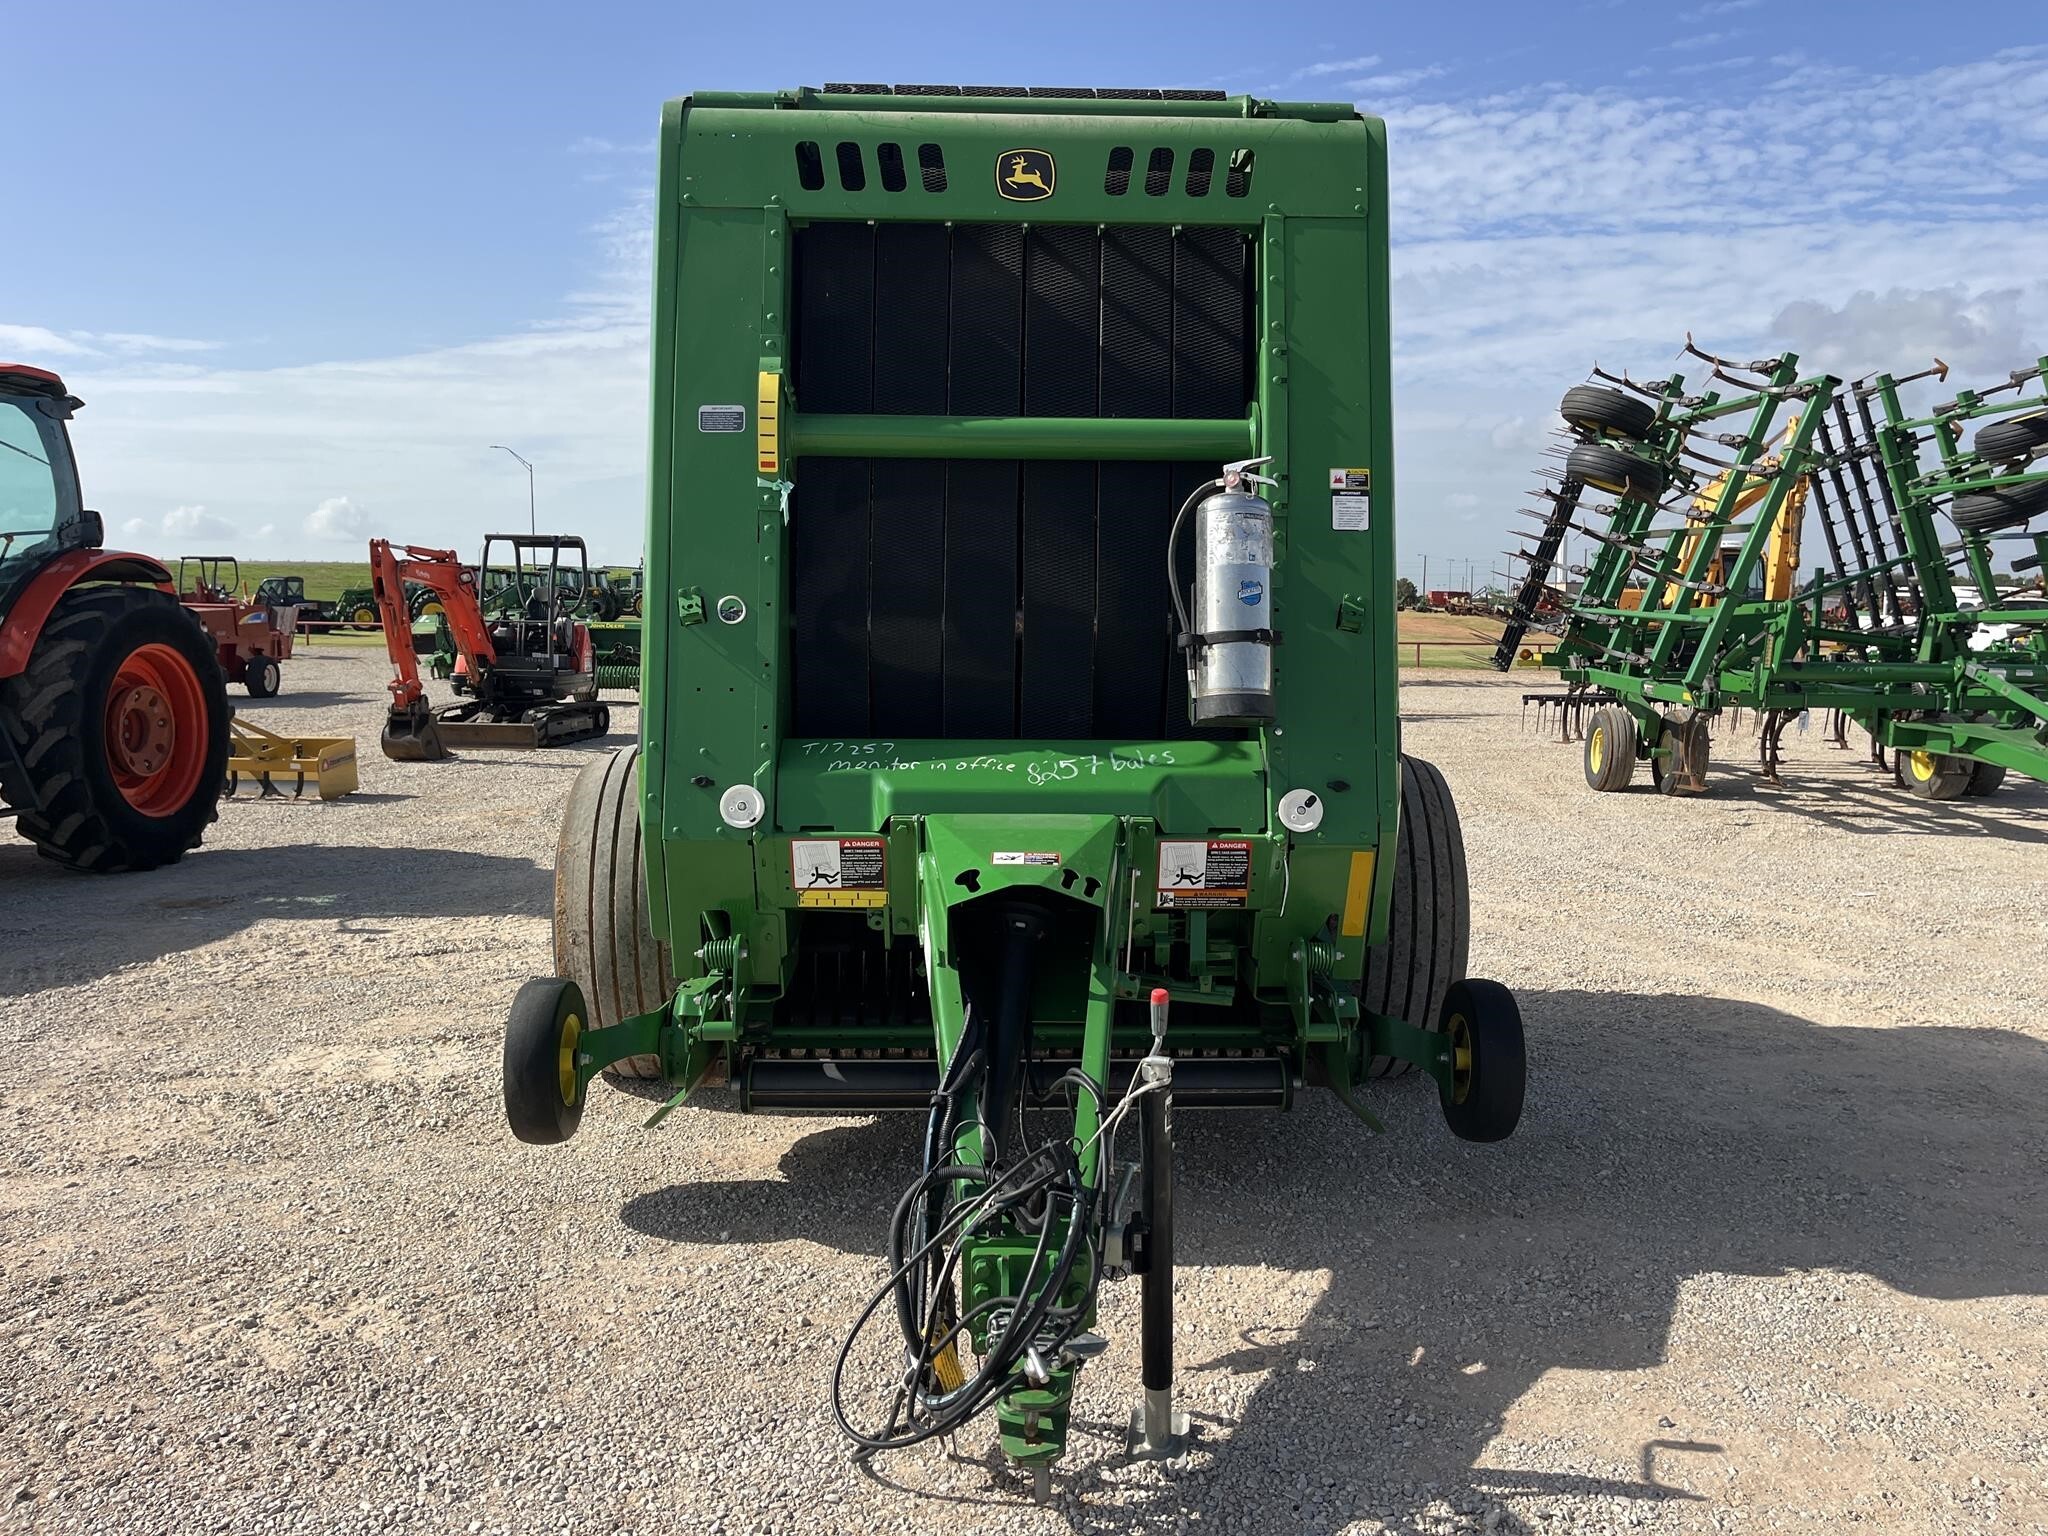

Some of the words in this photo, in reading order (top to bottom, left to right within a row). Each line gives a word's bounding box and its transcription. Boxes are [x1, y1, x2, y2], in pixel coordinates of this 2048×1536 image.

[802, 742, 896, 756] T17257
[827, 757, 921, 772] monitor
[930, 757, 947, 771] in
[955, 756, 1016, 773] office
[1109, 749, 1176, 772] bales
